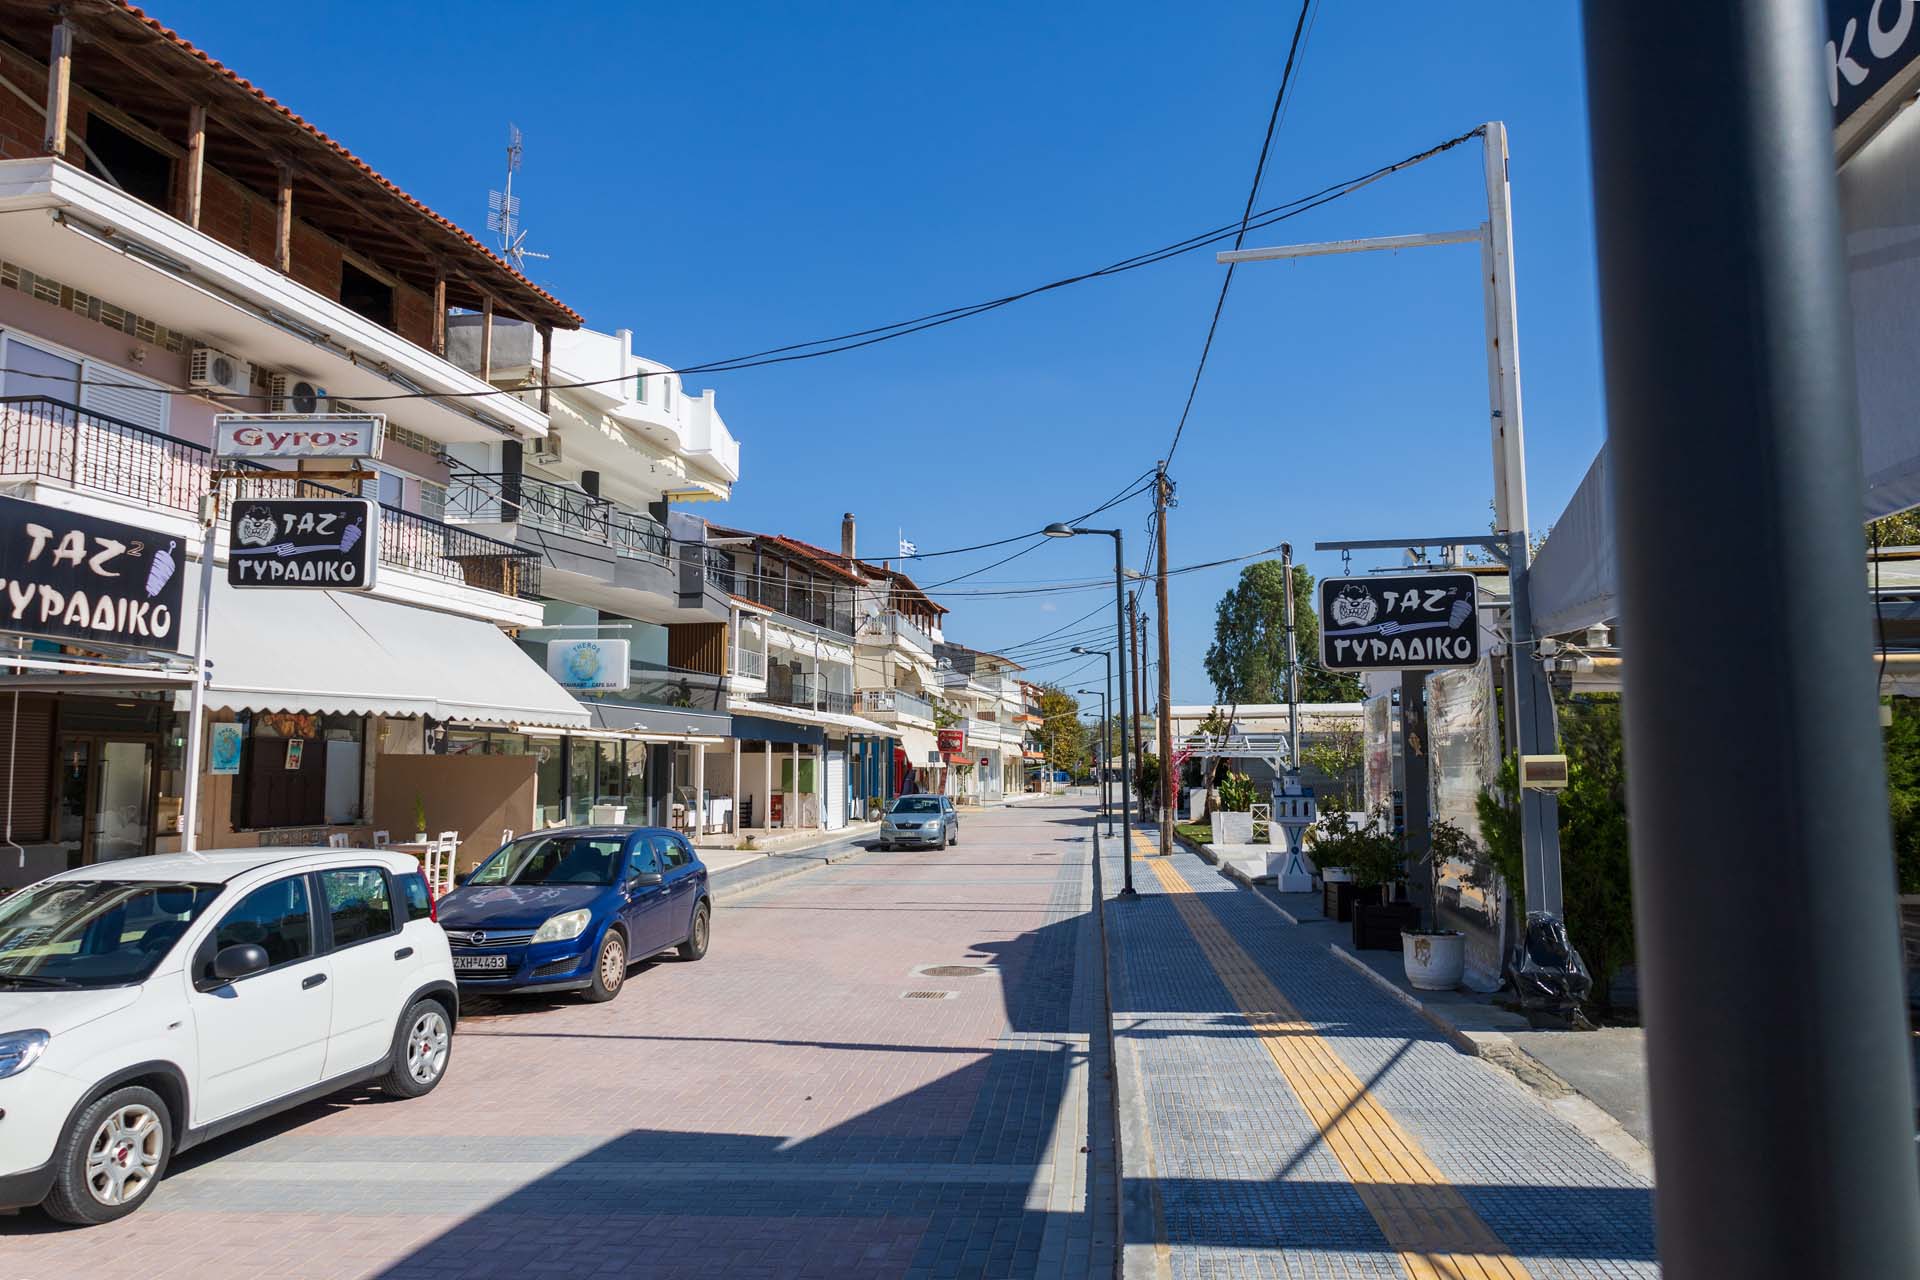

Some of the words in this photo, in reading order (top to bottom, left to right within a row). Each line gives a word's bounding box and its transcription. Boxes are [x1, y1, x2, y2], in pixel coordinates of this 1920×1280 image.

[232, 427, 359, 450] Gyros
[238, 559, 356, 582] ΓΥΡΑΔΙΚΟ
[0, 578, 171, 639] ΥΡΑΔΙΚΟ
[1334, 636, 1471, 662] ΓΥΡΑΔΙΚΟ
